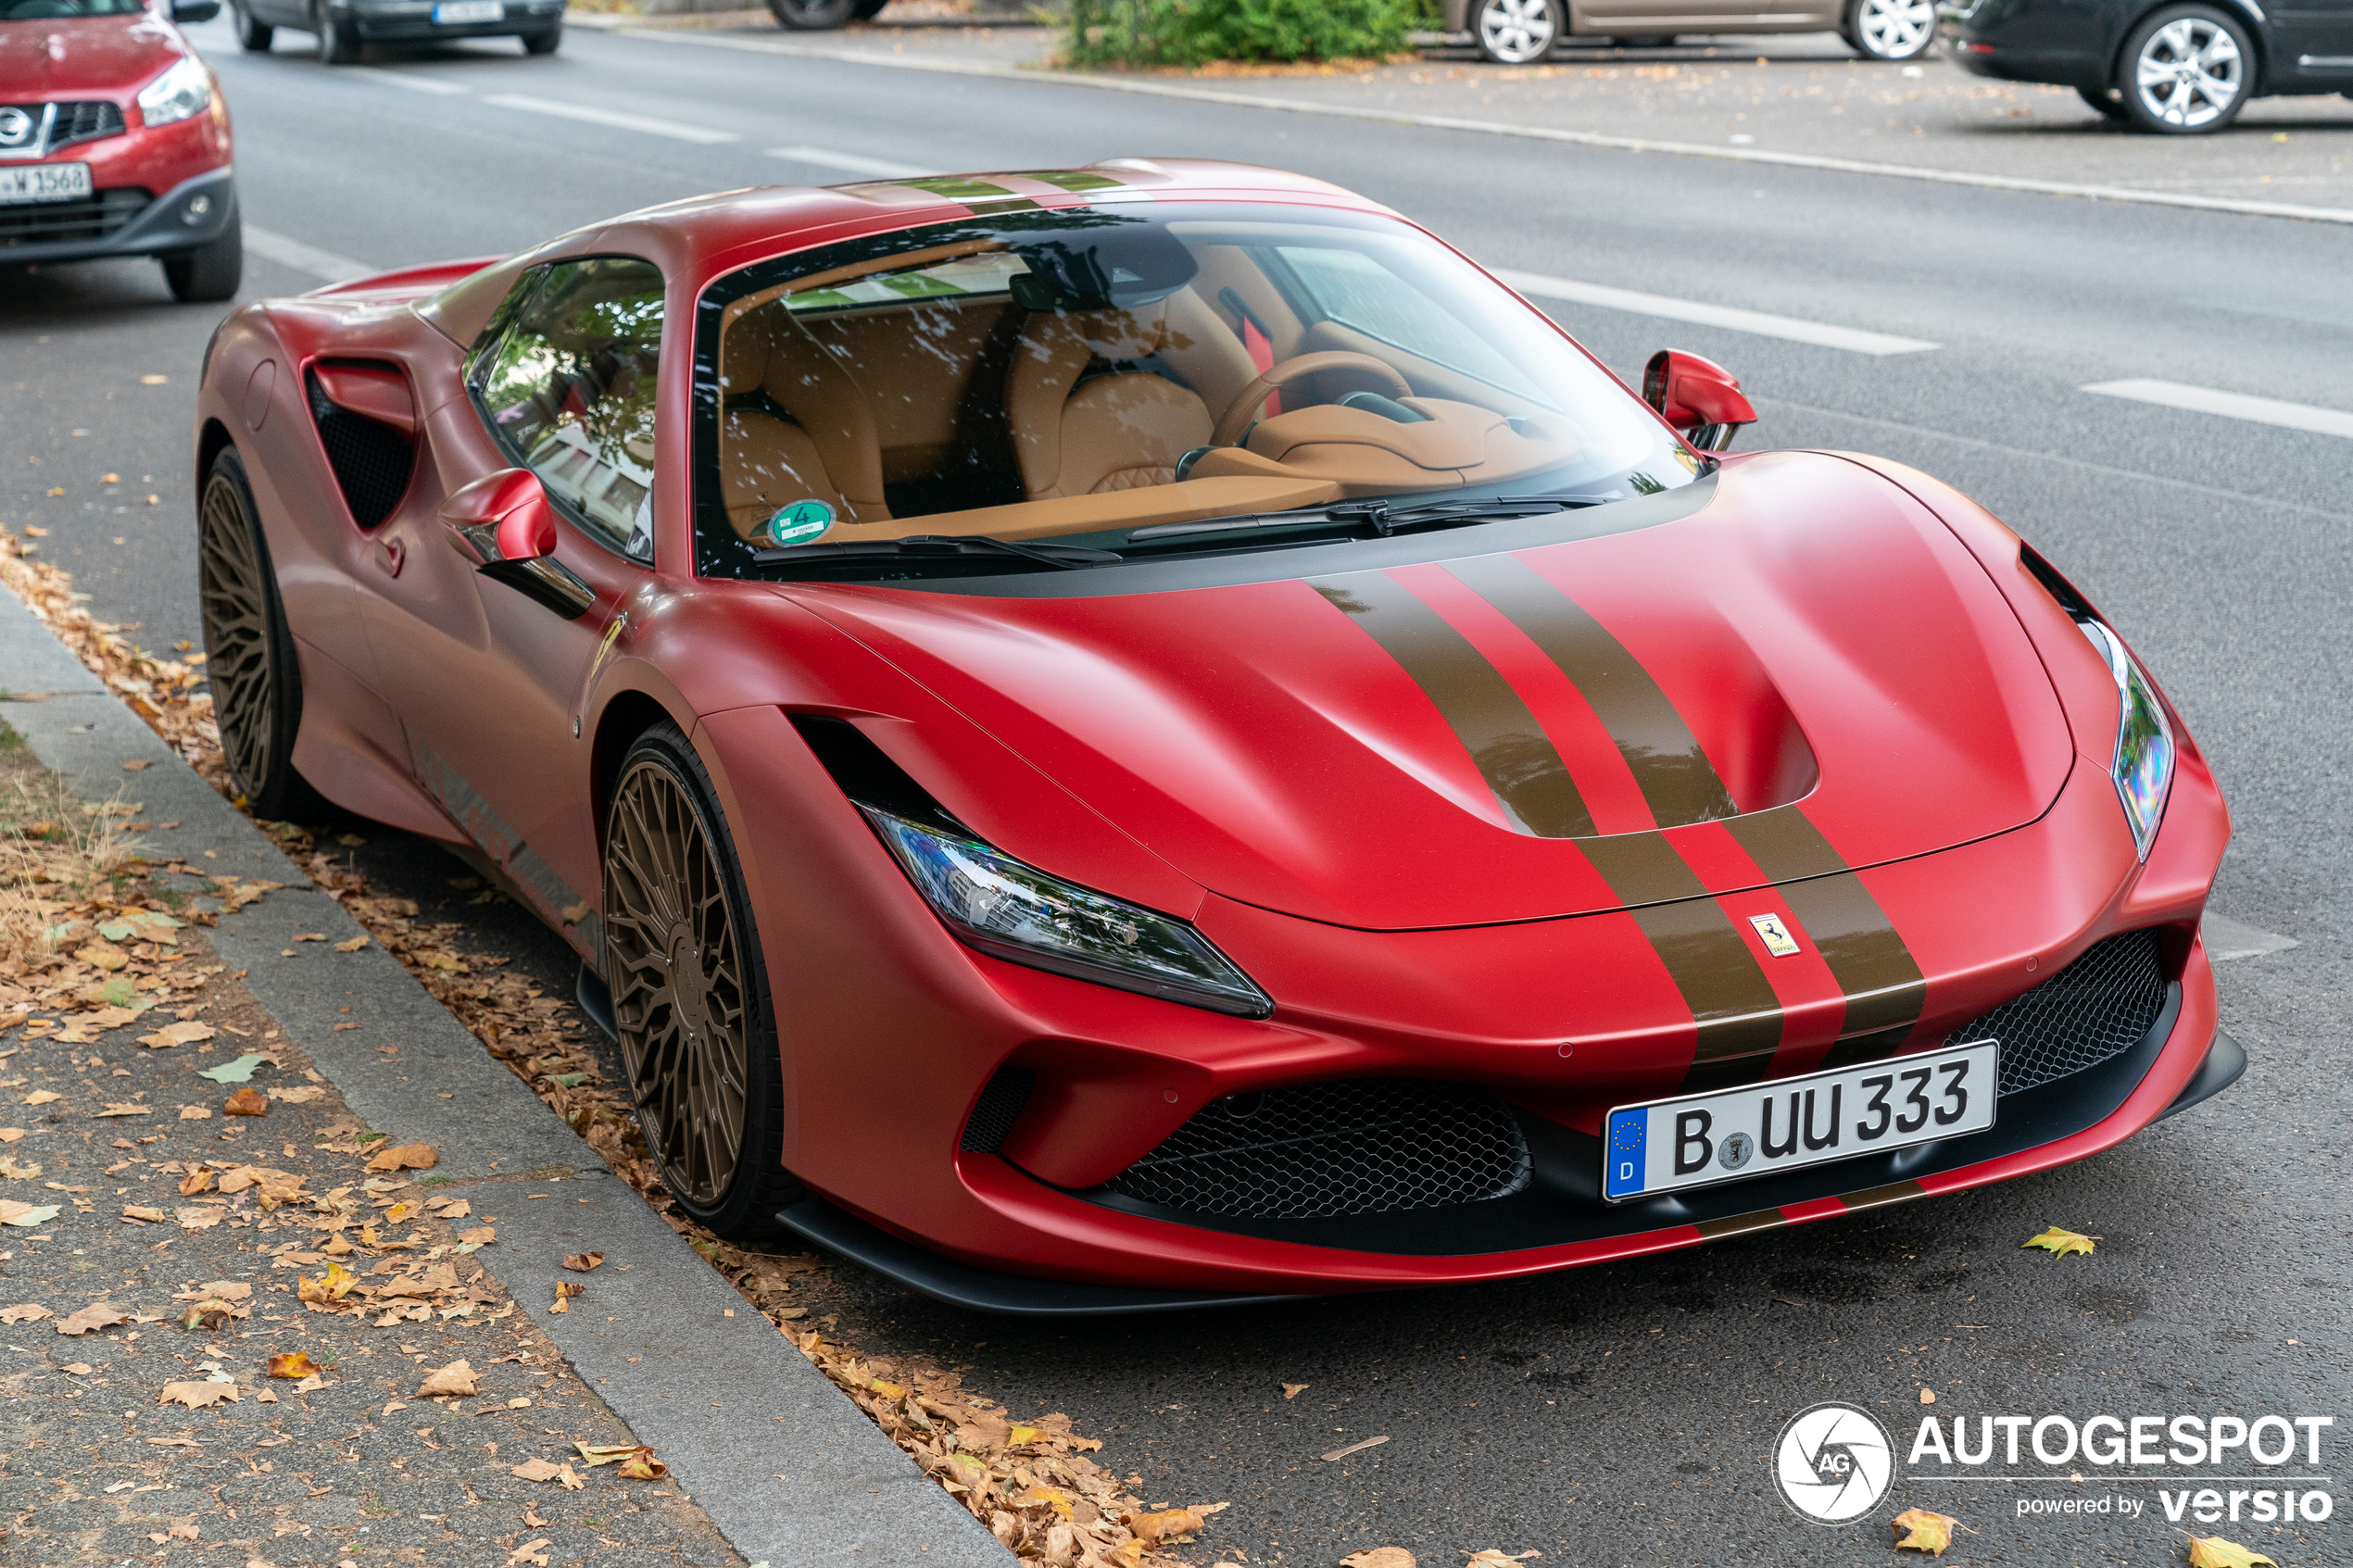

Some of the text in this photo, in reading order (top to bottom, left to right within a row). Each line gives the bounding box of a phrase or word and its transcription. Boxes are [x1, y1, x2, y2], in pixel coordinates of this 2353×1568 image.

[34, 169, 83, 193] 1568
[794, 506, 810, 522] 4
[1673, 1059, 1970, 1176] B UU 333
[1619, 1161, 1633, 1181] D
